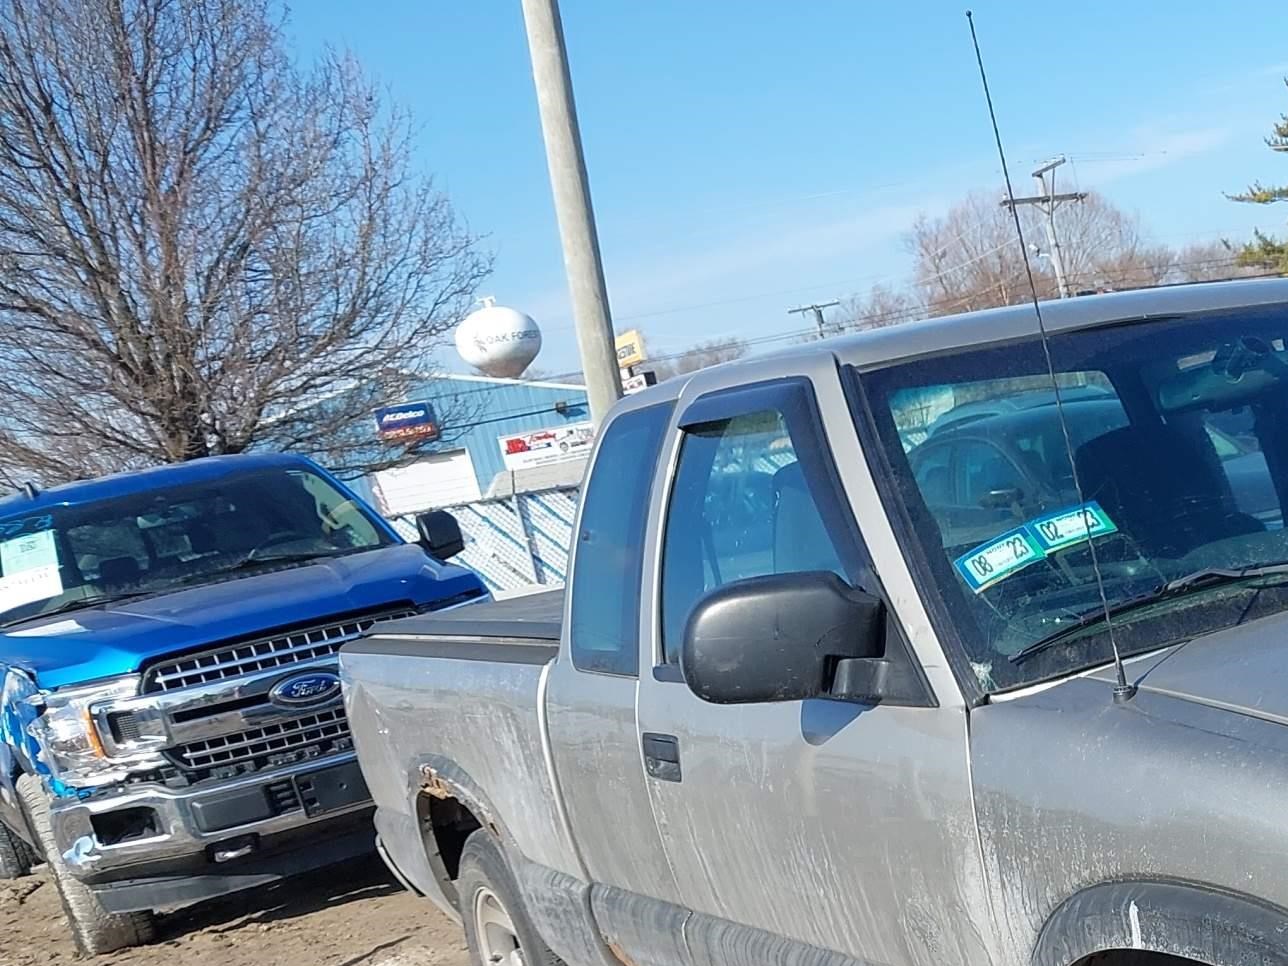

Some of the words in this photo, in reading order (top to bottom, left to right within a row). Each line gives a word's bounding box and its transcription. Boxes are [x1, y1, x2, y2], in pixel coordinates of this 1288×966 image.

[486, 332, 509, 345] OAK
[971, 555, 994, 577] 08
[1006, 536, 1030, 560] 23
[290, 679, 327, 698] Ford
